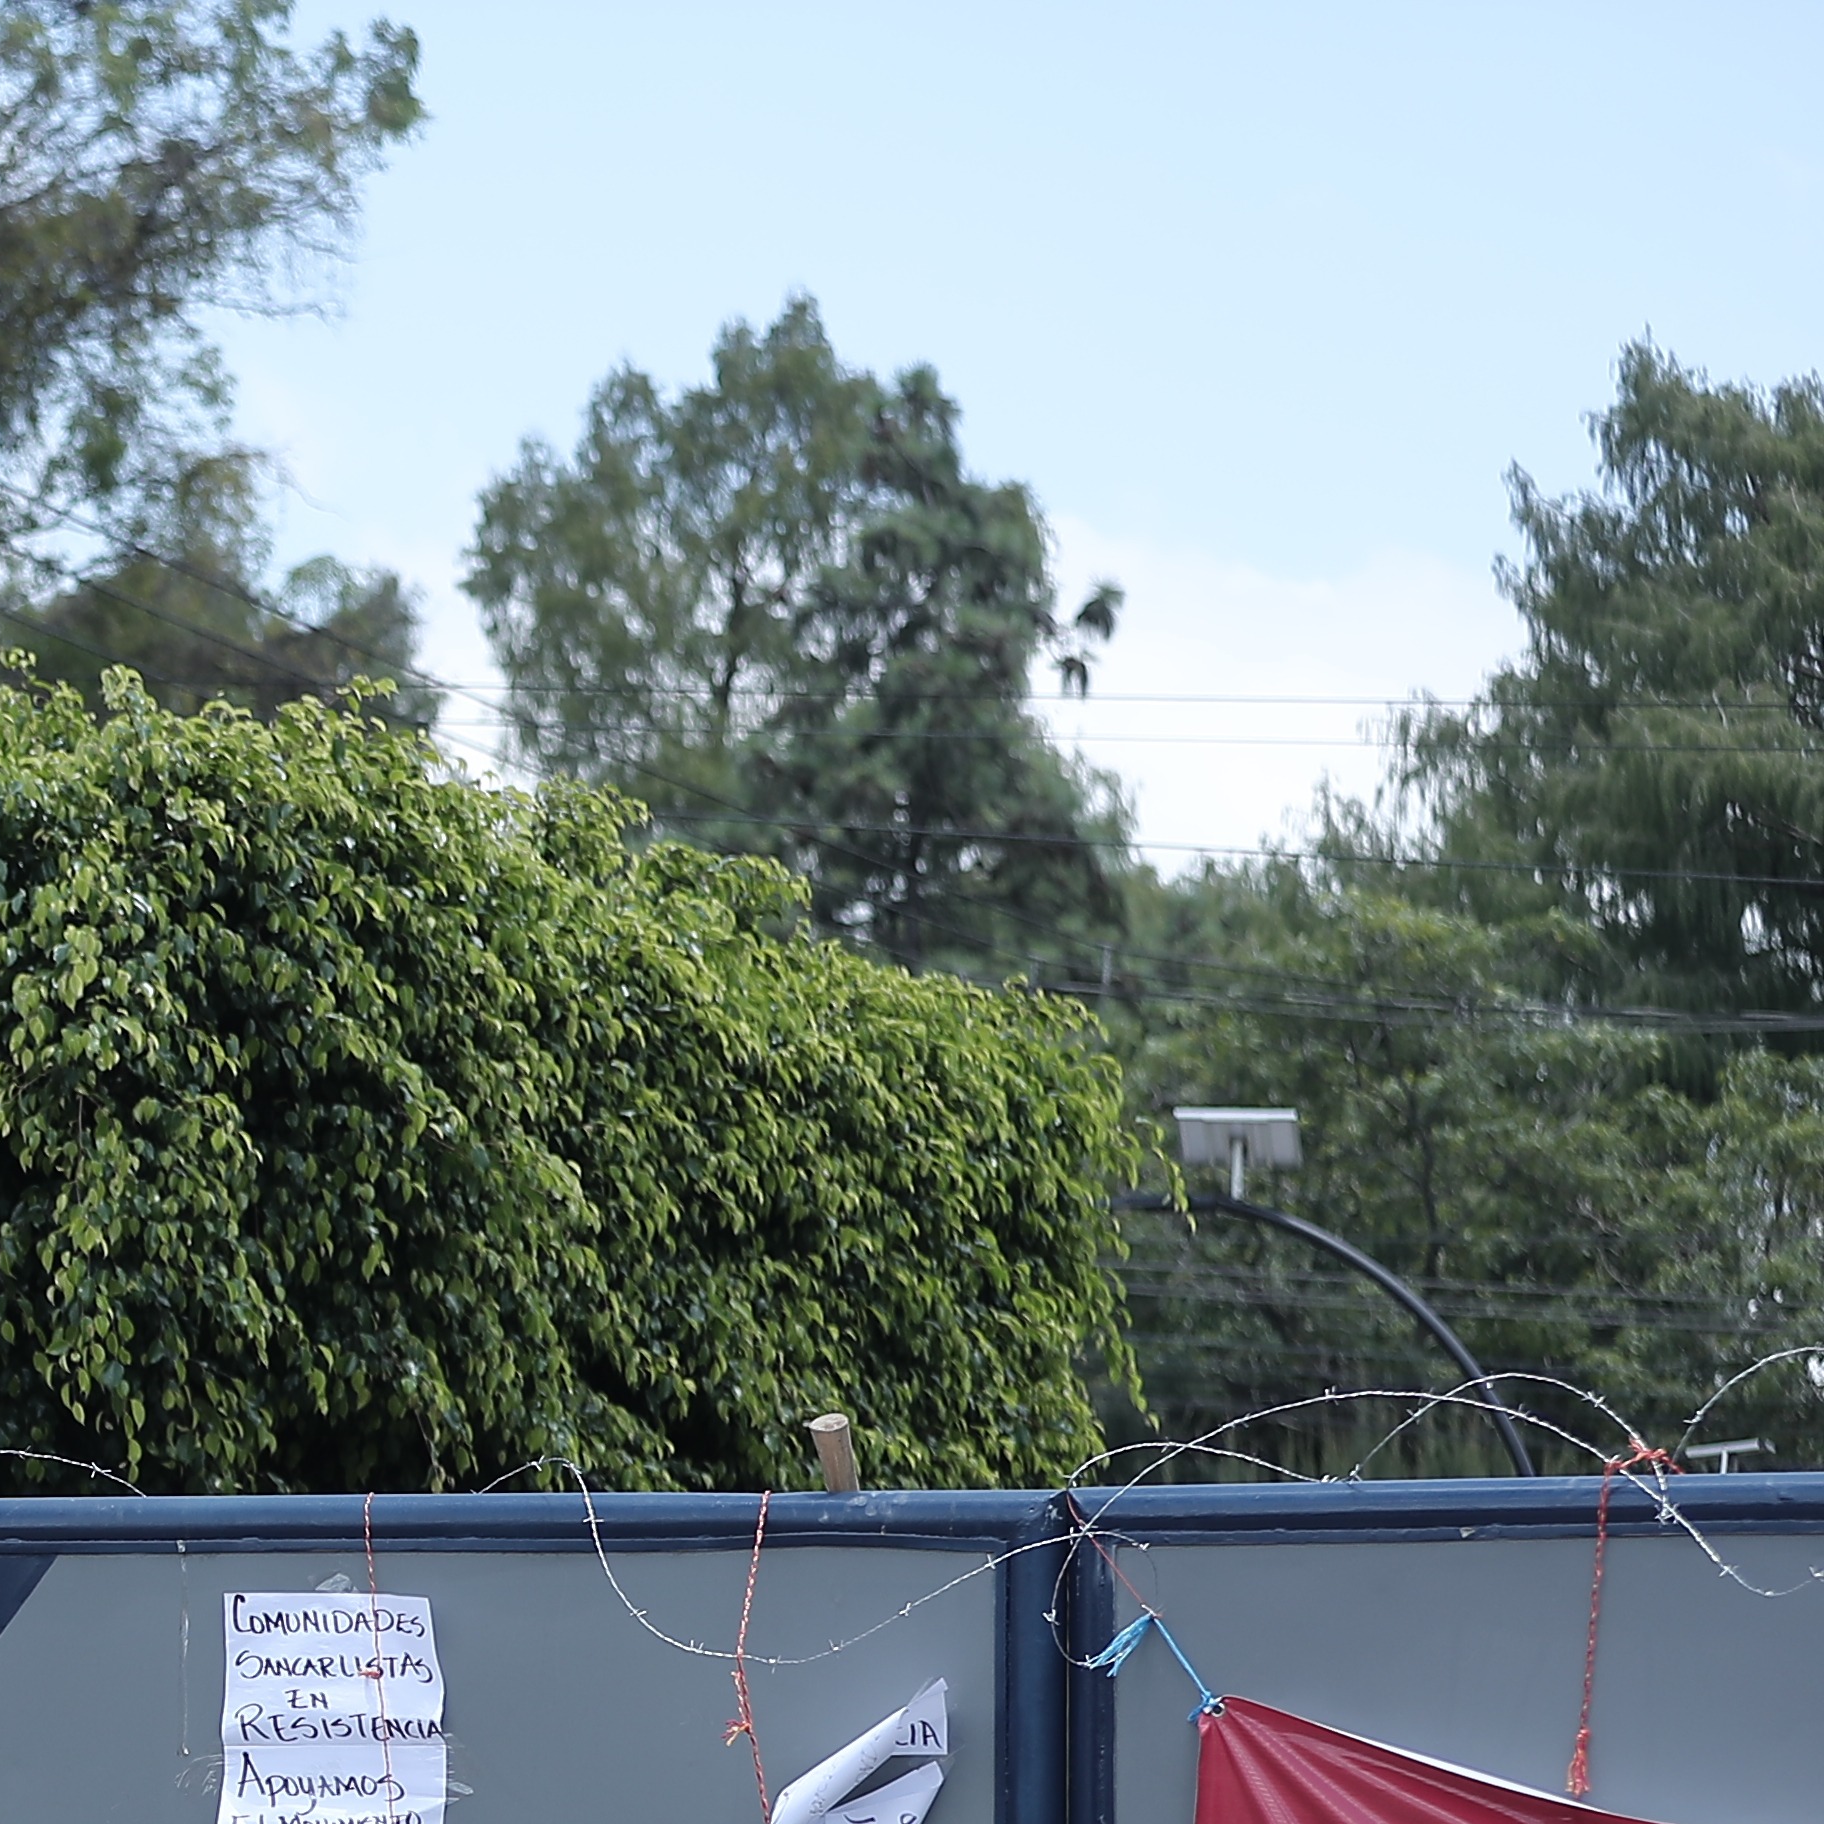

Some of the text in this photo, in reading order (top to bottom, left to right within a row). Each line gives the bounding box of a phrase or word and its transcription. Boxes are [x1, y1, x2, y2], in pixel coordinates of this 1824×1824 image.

[233, 1594, 424, 1637] COMUNIDADES
[285, 1689, 329, 1709] EN
[235, 1704, 443, 1743] RESISTENCIA
[238, 1753, 405, 1815] APOYAMOS
